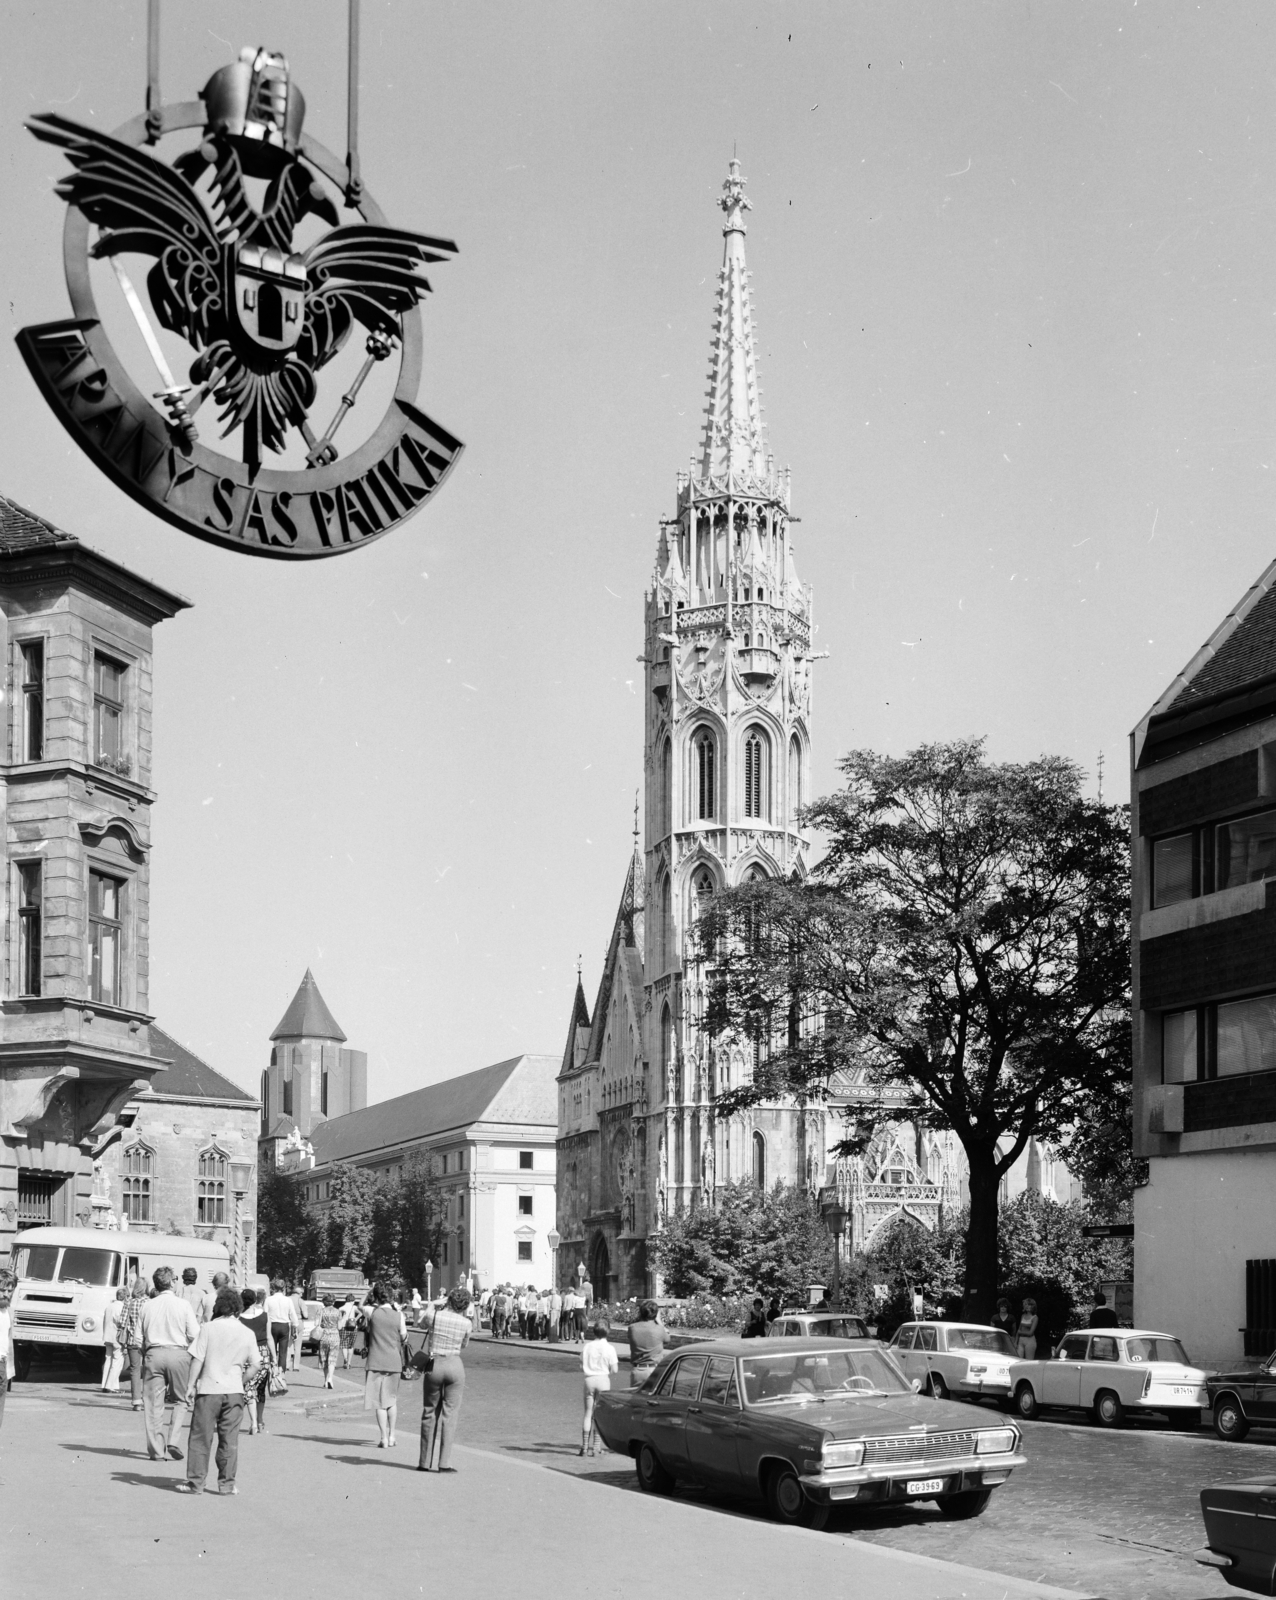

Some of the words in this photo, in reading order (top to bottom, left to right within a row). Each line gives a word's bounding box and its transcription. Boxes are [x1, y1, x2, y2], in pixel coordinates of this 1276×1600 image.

[36, 343, 198, 502] ARANY
[204, 478, 298, 548] SAS
[310, 433, 451, 547] PATIKA
